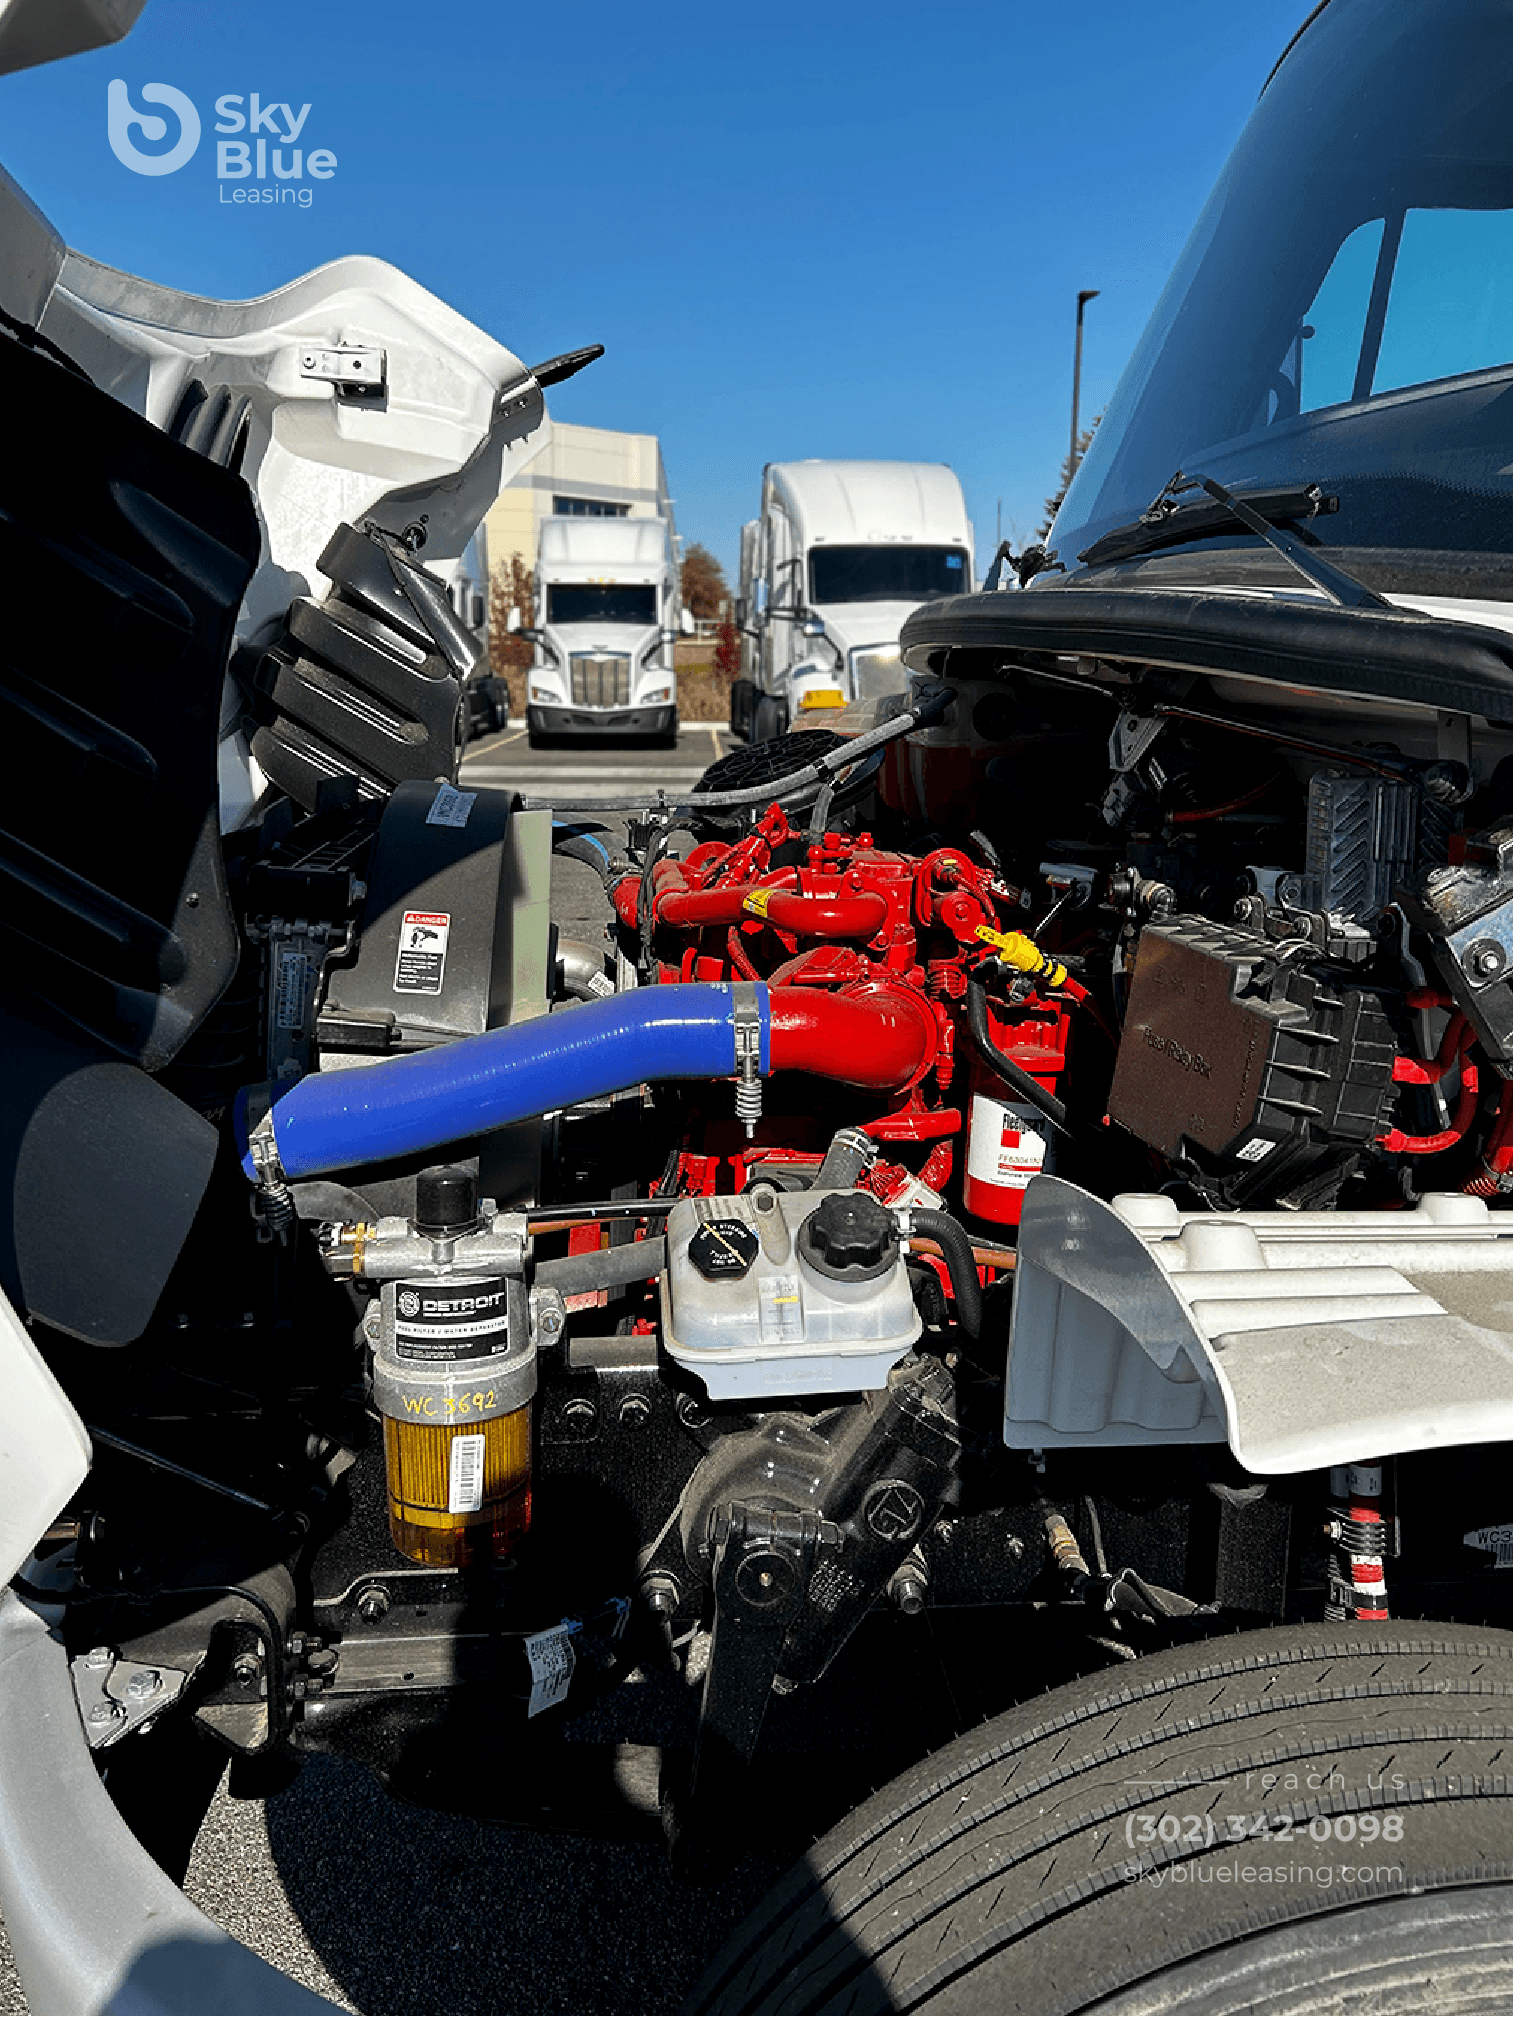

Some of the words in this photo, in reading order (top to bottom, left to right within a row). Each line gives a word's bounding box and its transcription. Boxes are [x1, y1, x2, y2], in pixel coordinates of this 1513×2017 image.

[422, 1292, 505, 1311] DETROIT
[402, 1395, 439, 1416] WC
[443, 1389, 497, 1414] 3692
